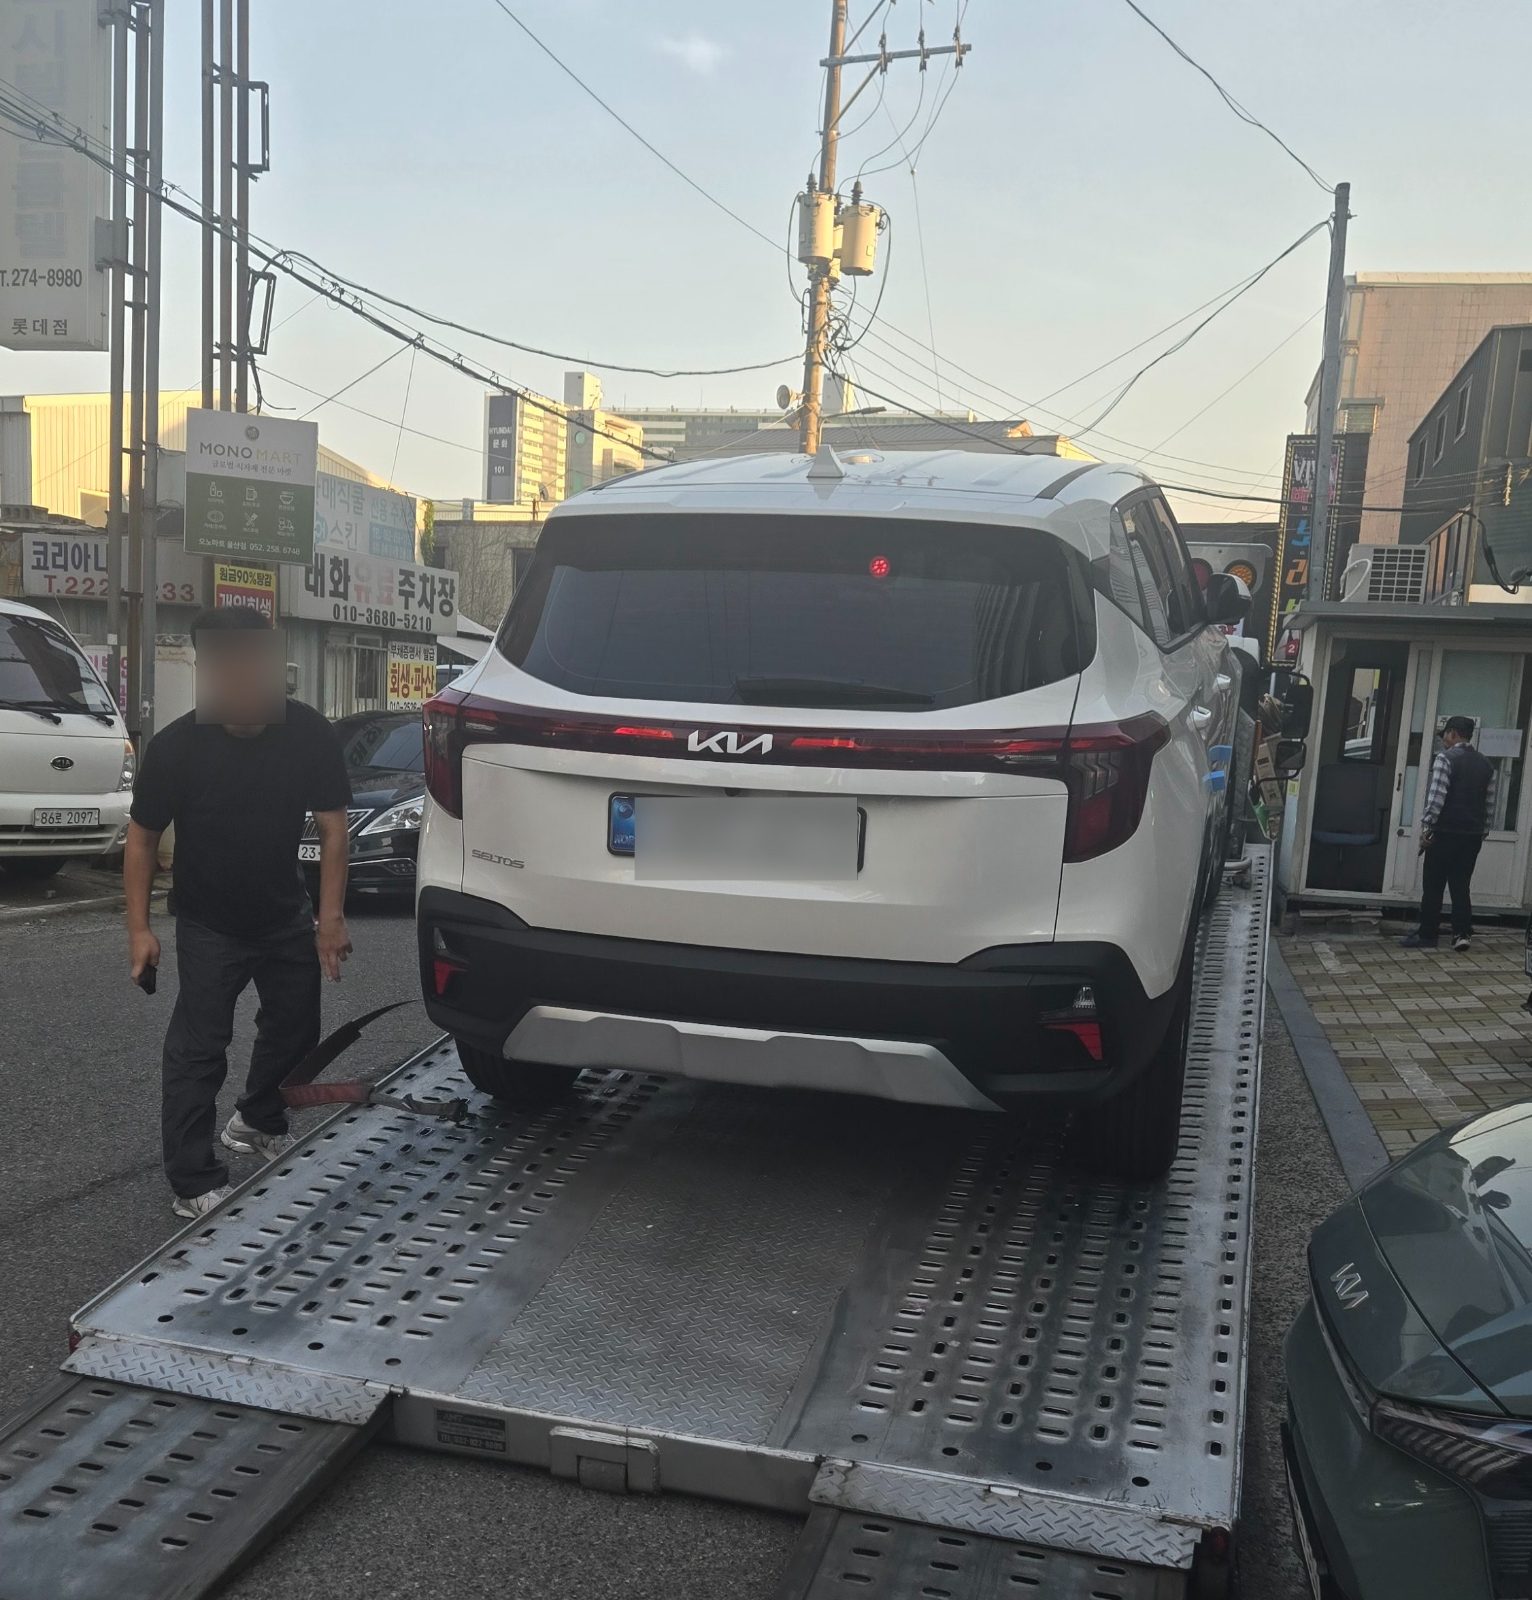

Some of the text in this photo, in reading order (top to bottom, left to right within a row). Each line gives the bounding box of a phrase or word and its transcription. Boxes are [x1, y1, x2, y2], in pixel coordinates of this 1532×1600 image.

[11, 318, 68, 336] 롯데점
[494, 466, 505, 474] 101
[332, 602, 432, 632] 010-3680-5210
[687, 729, 773, 756] KIA
[40, 811, 94, 825] 86로 2097
[302, 846, 320, 859] 23
[471, 849, 525, 869] SELTOS
